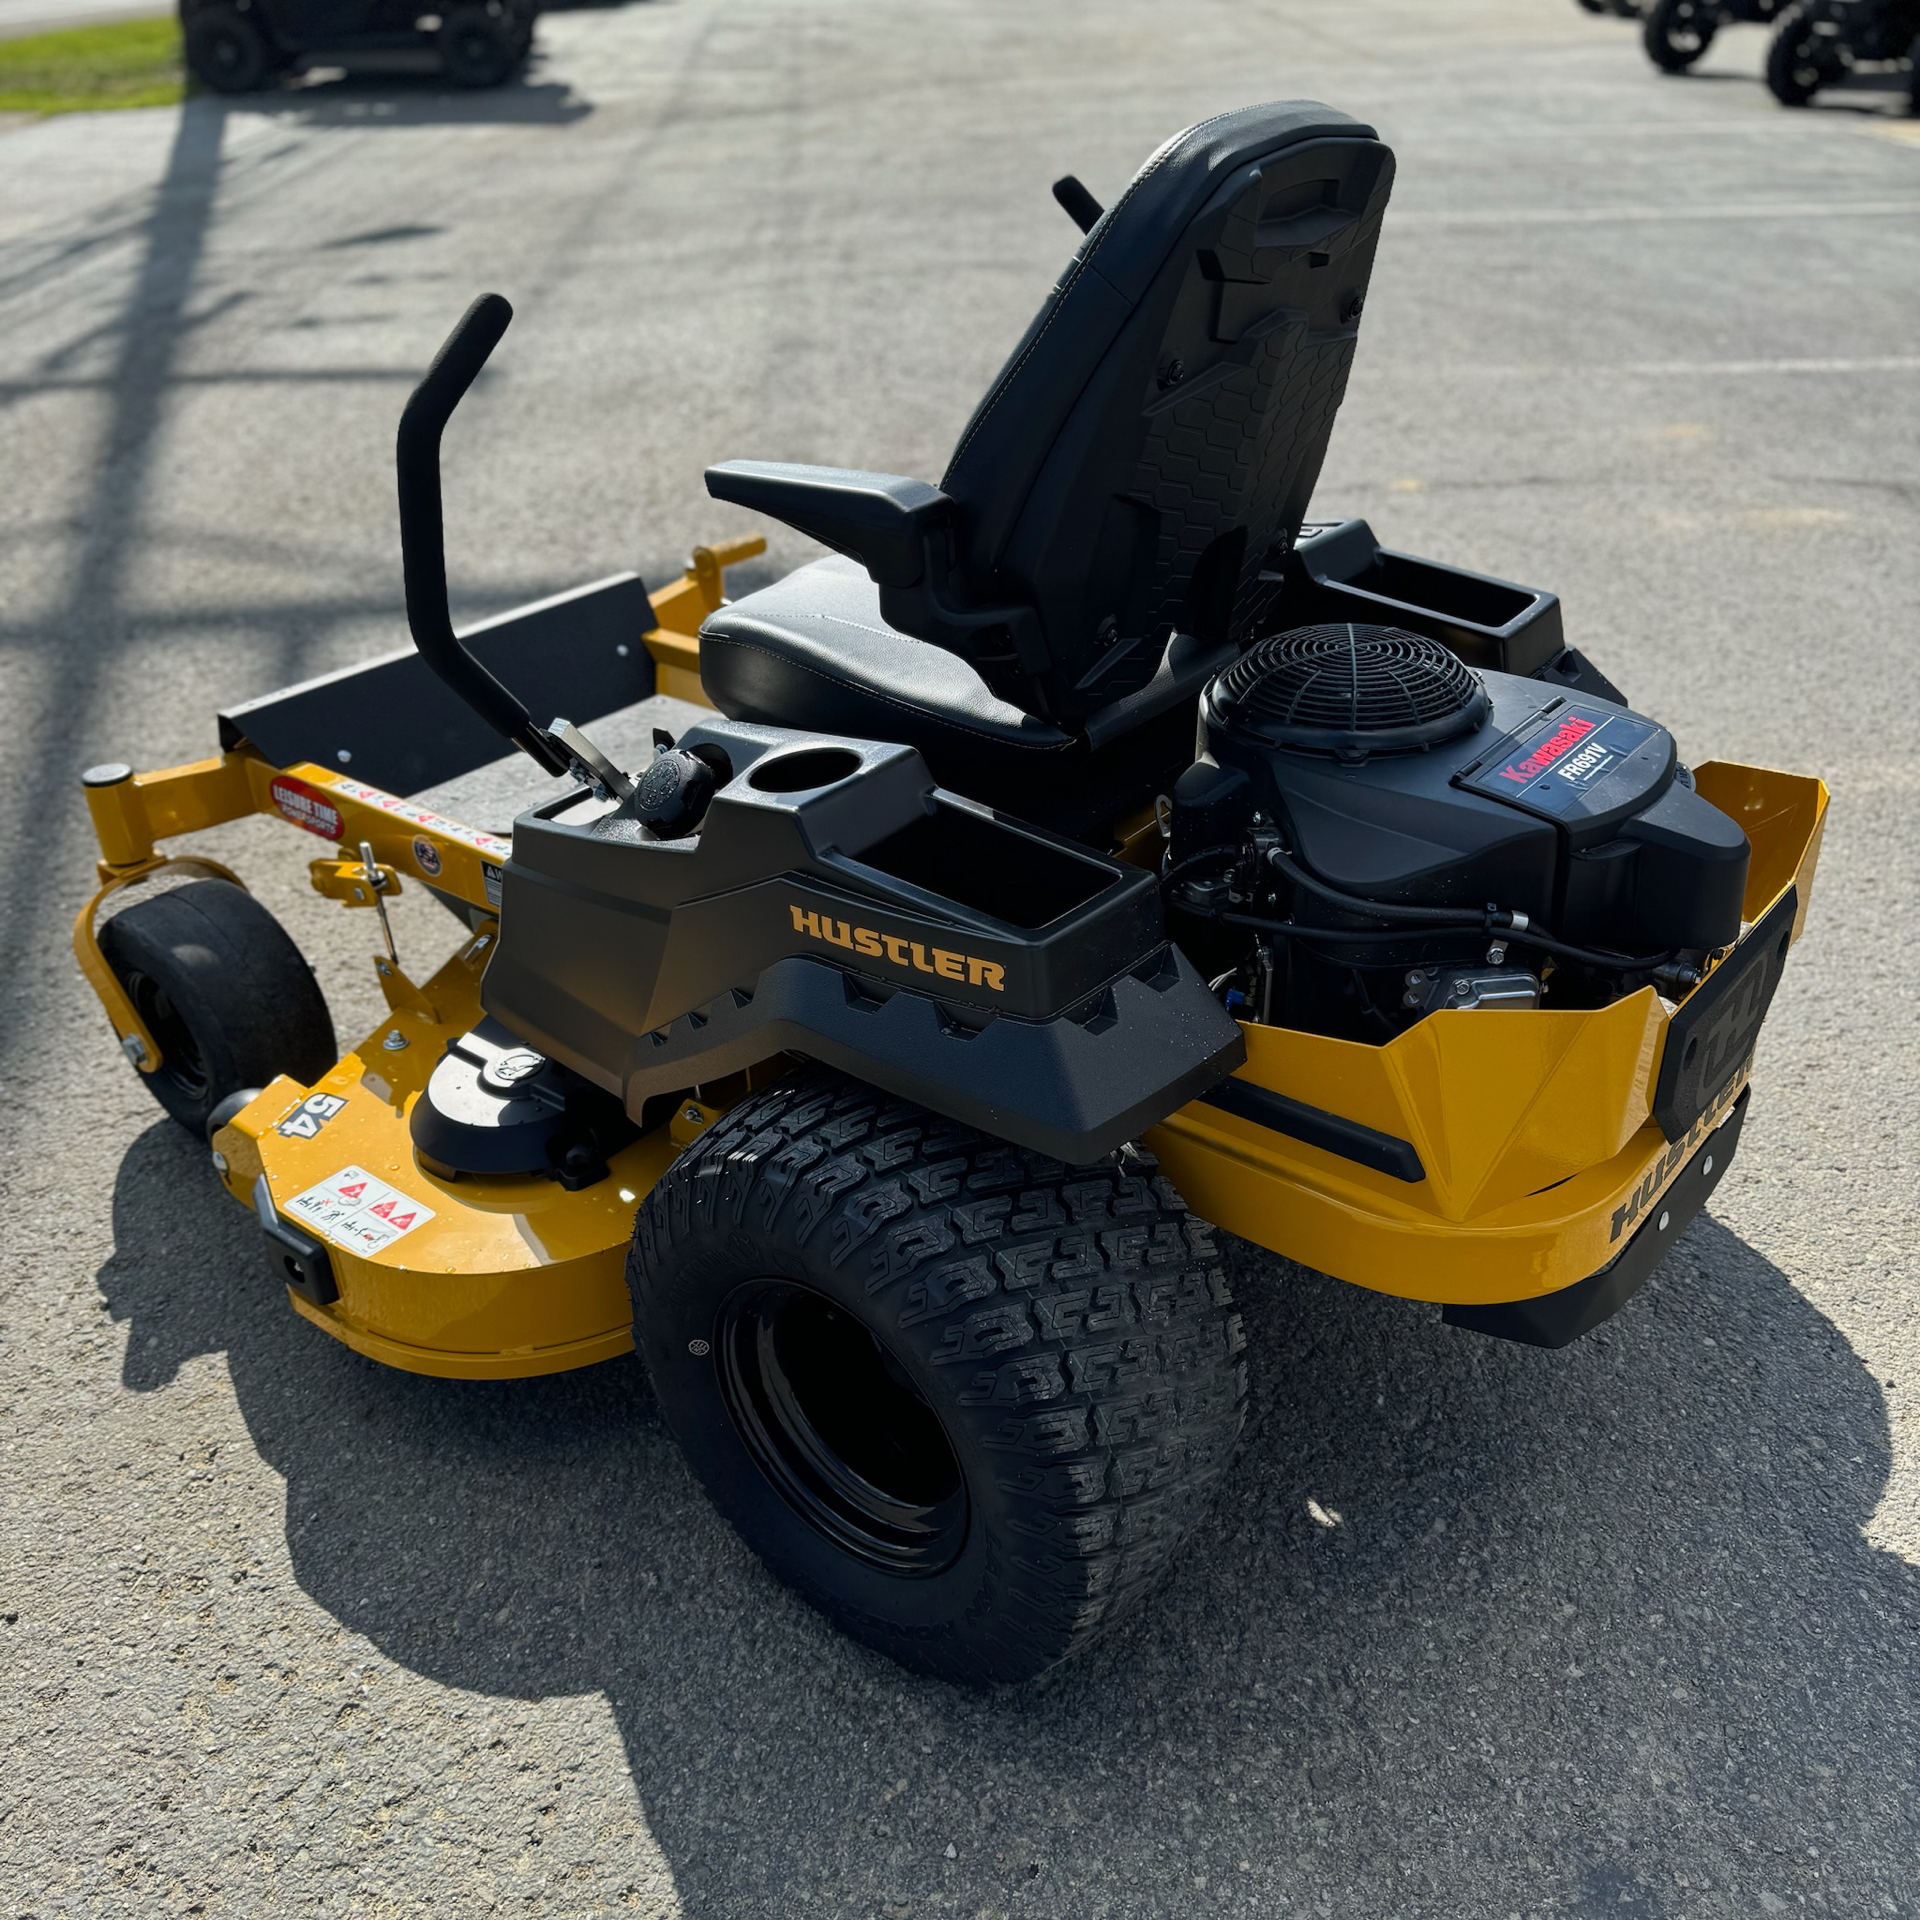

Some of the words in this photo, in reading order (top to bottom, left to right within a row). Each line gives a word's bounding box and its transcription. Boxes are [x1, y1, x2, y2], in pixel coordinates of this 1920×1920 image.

[1499, 716, 1597, 784] Kawasaki
[1557, 742, 1608, 781] FR691V
[273, 785, 313, 815] LEISURE
[313, 801, 338, 826] TIME
[789, 904, 1005, 992] HUSTLER
[278, 1093, 349, 1139] 54
